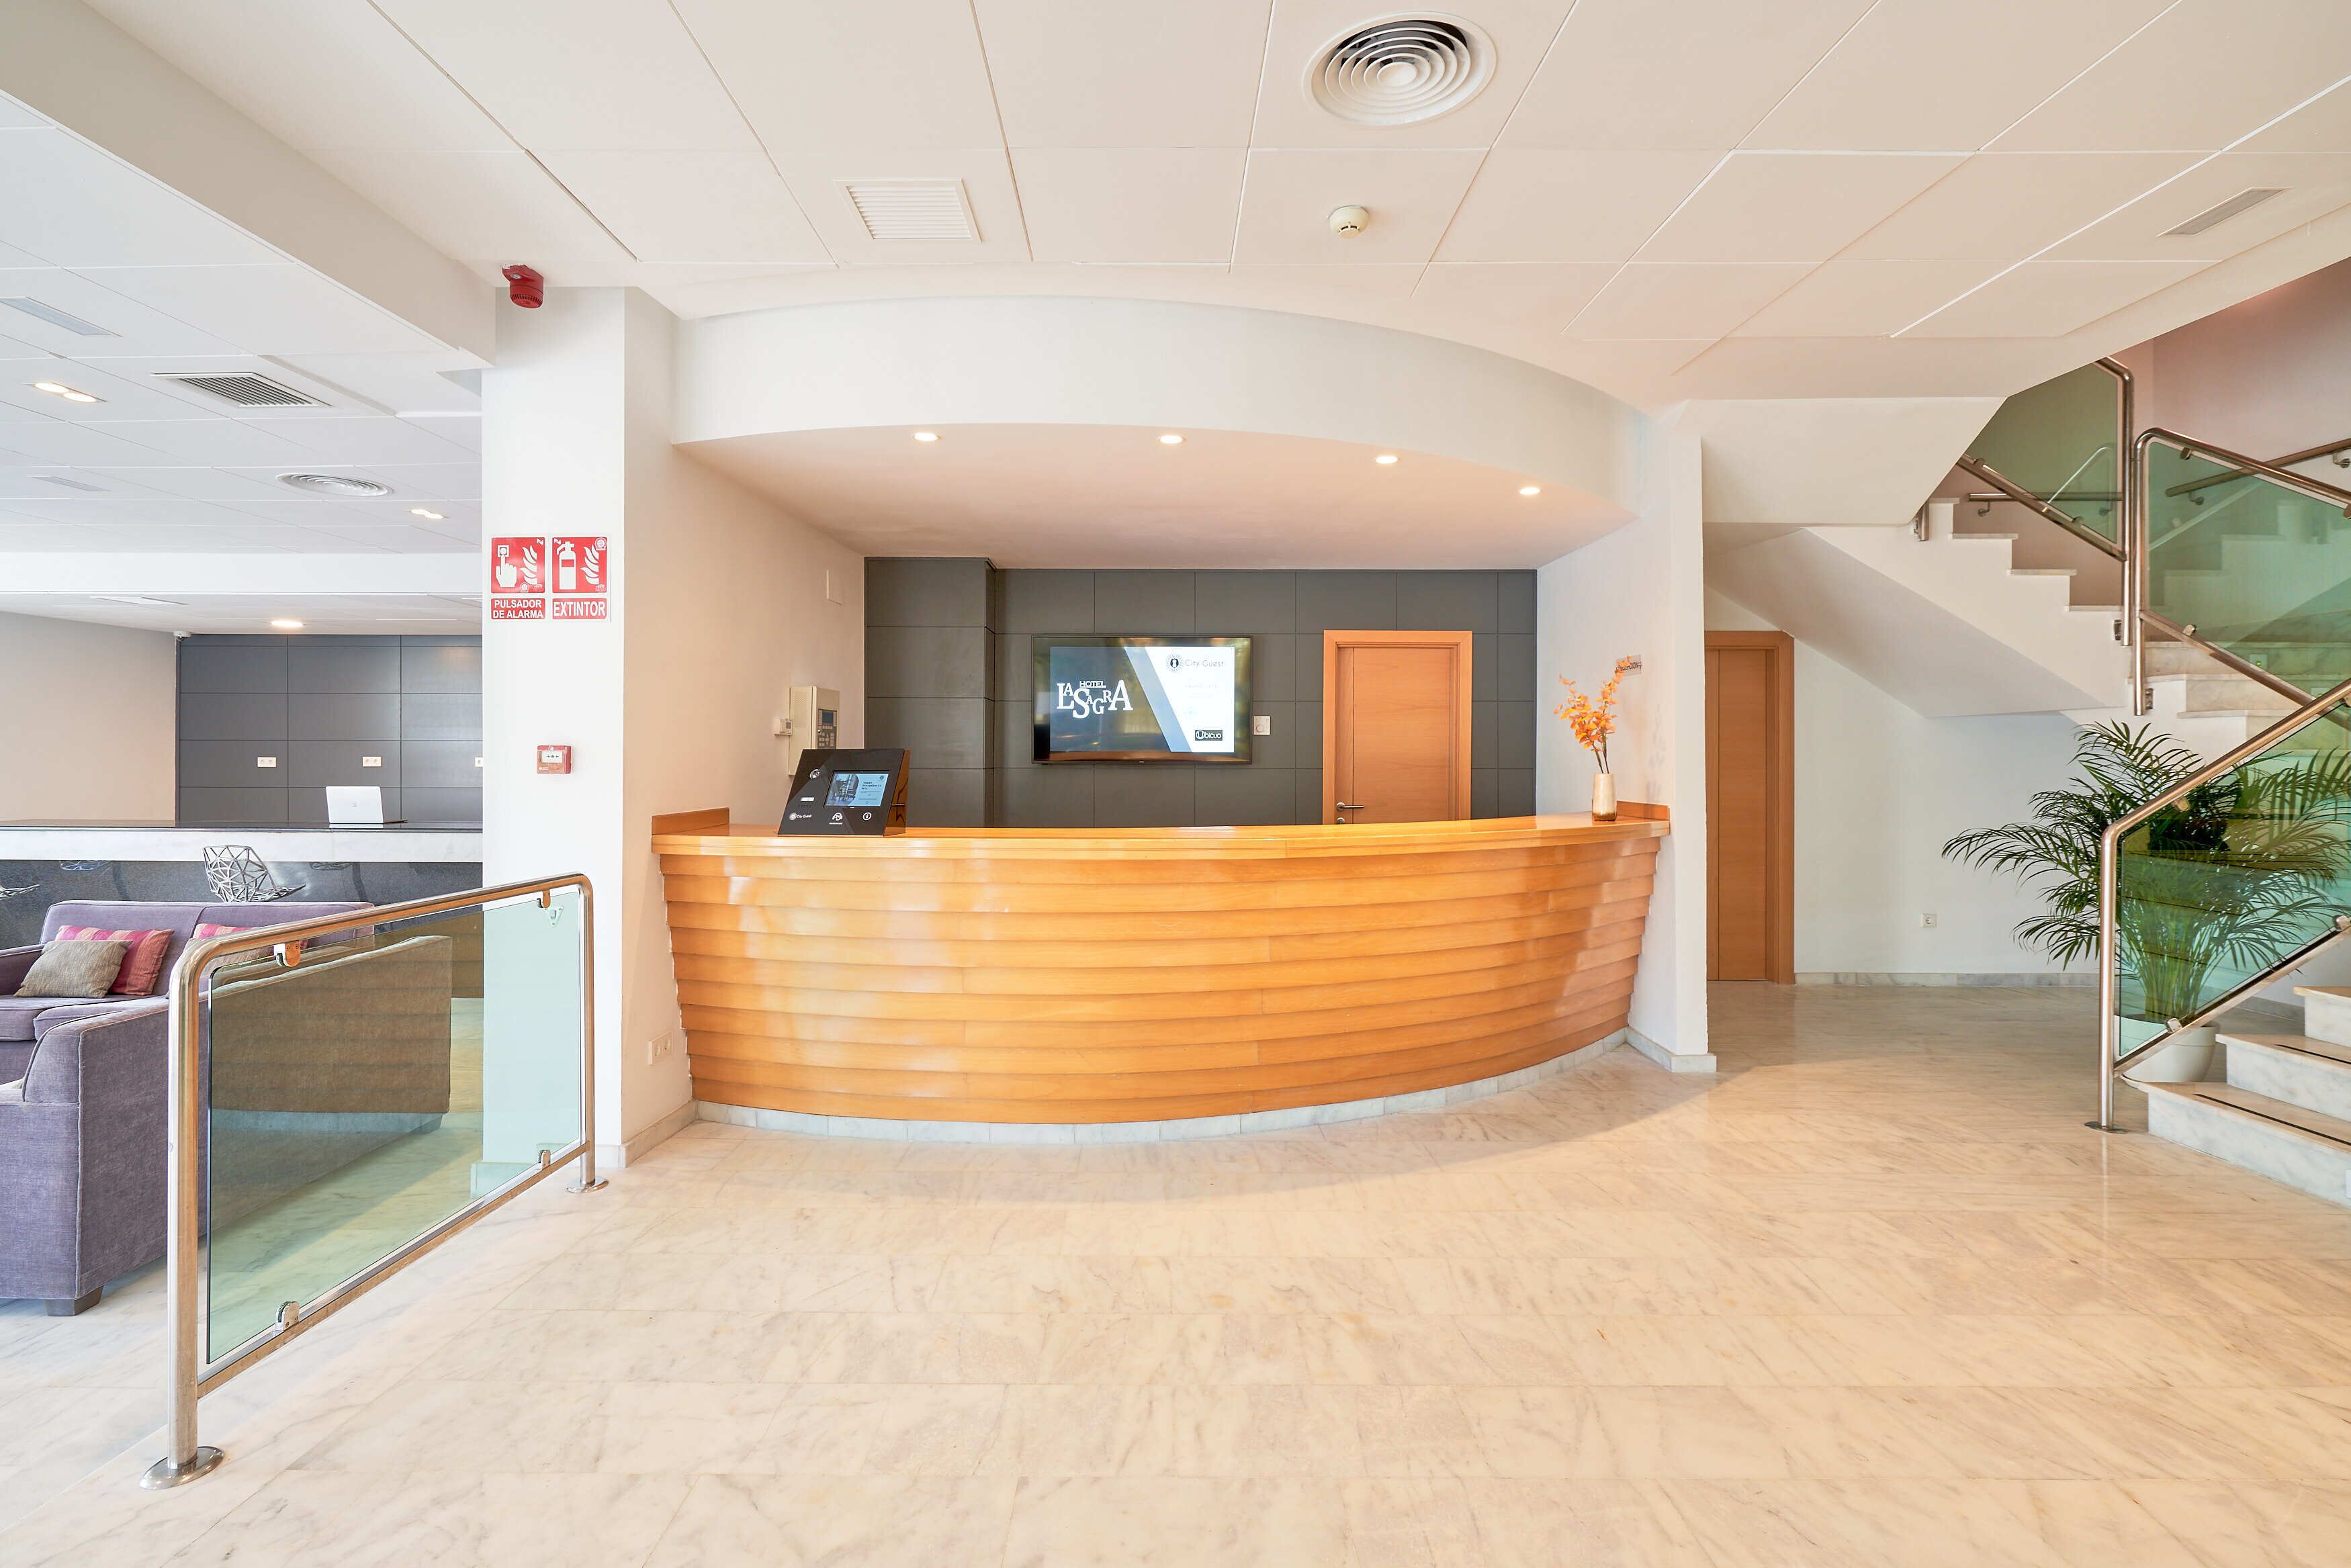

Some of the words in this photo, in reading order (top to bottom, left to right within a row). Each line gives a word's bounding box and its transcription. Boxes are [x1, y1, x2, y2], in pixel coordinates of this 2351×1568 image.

[494, 600, 542, 608] PULSADOR
[553, 601, 606, 616] EXTINTOR
[493, 610, 505, 618] DE
[506, 610, 543, 618] ALARMA
[1185, 659, 1200, 668] City
[1202, 659, 1225, 667] Guest
[1079, 680, 1107, 688] HOTEL
[1056, 682, 1075, 710] LA
[1073, 680, 1134, 719] SAGRA
[1196, 730, 1222, 740] Ubicuo
